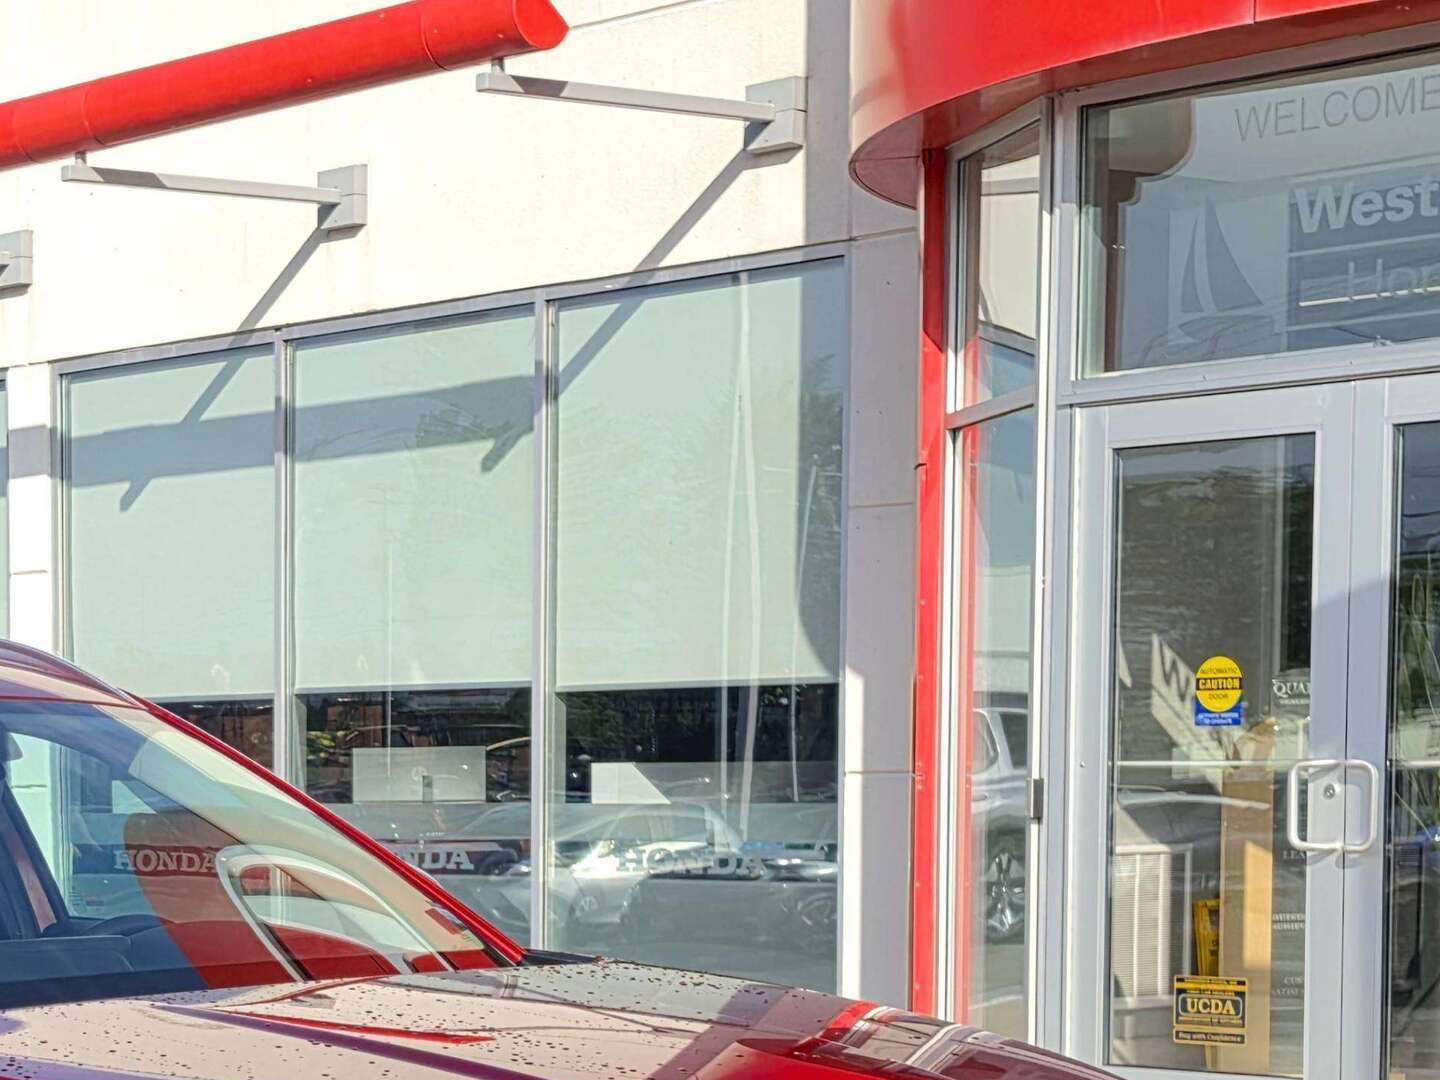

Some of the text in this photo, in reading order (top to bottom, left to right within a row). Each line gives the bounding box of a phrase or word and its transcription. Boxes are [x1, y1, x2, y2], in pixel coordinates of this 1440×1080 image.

[1234, 74, 1440, 142] WELCOME
[1294, 180, 1440, 234] West
[1199, 678, 1241, 690] CAUTION
[113, 848, 216, 874] HONDA
[1186, 998, 1236, 1015] UCDA
